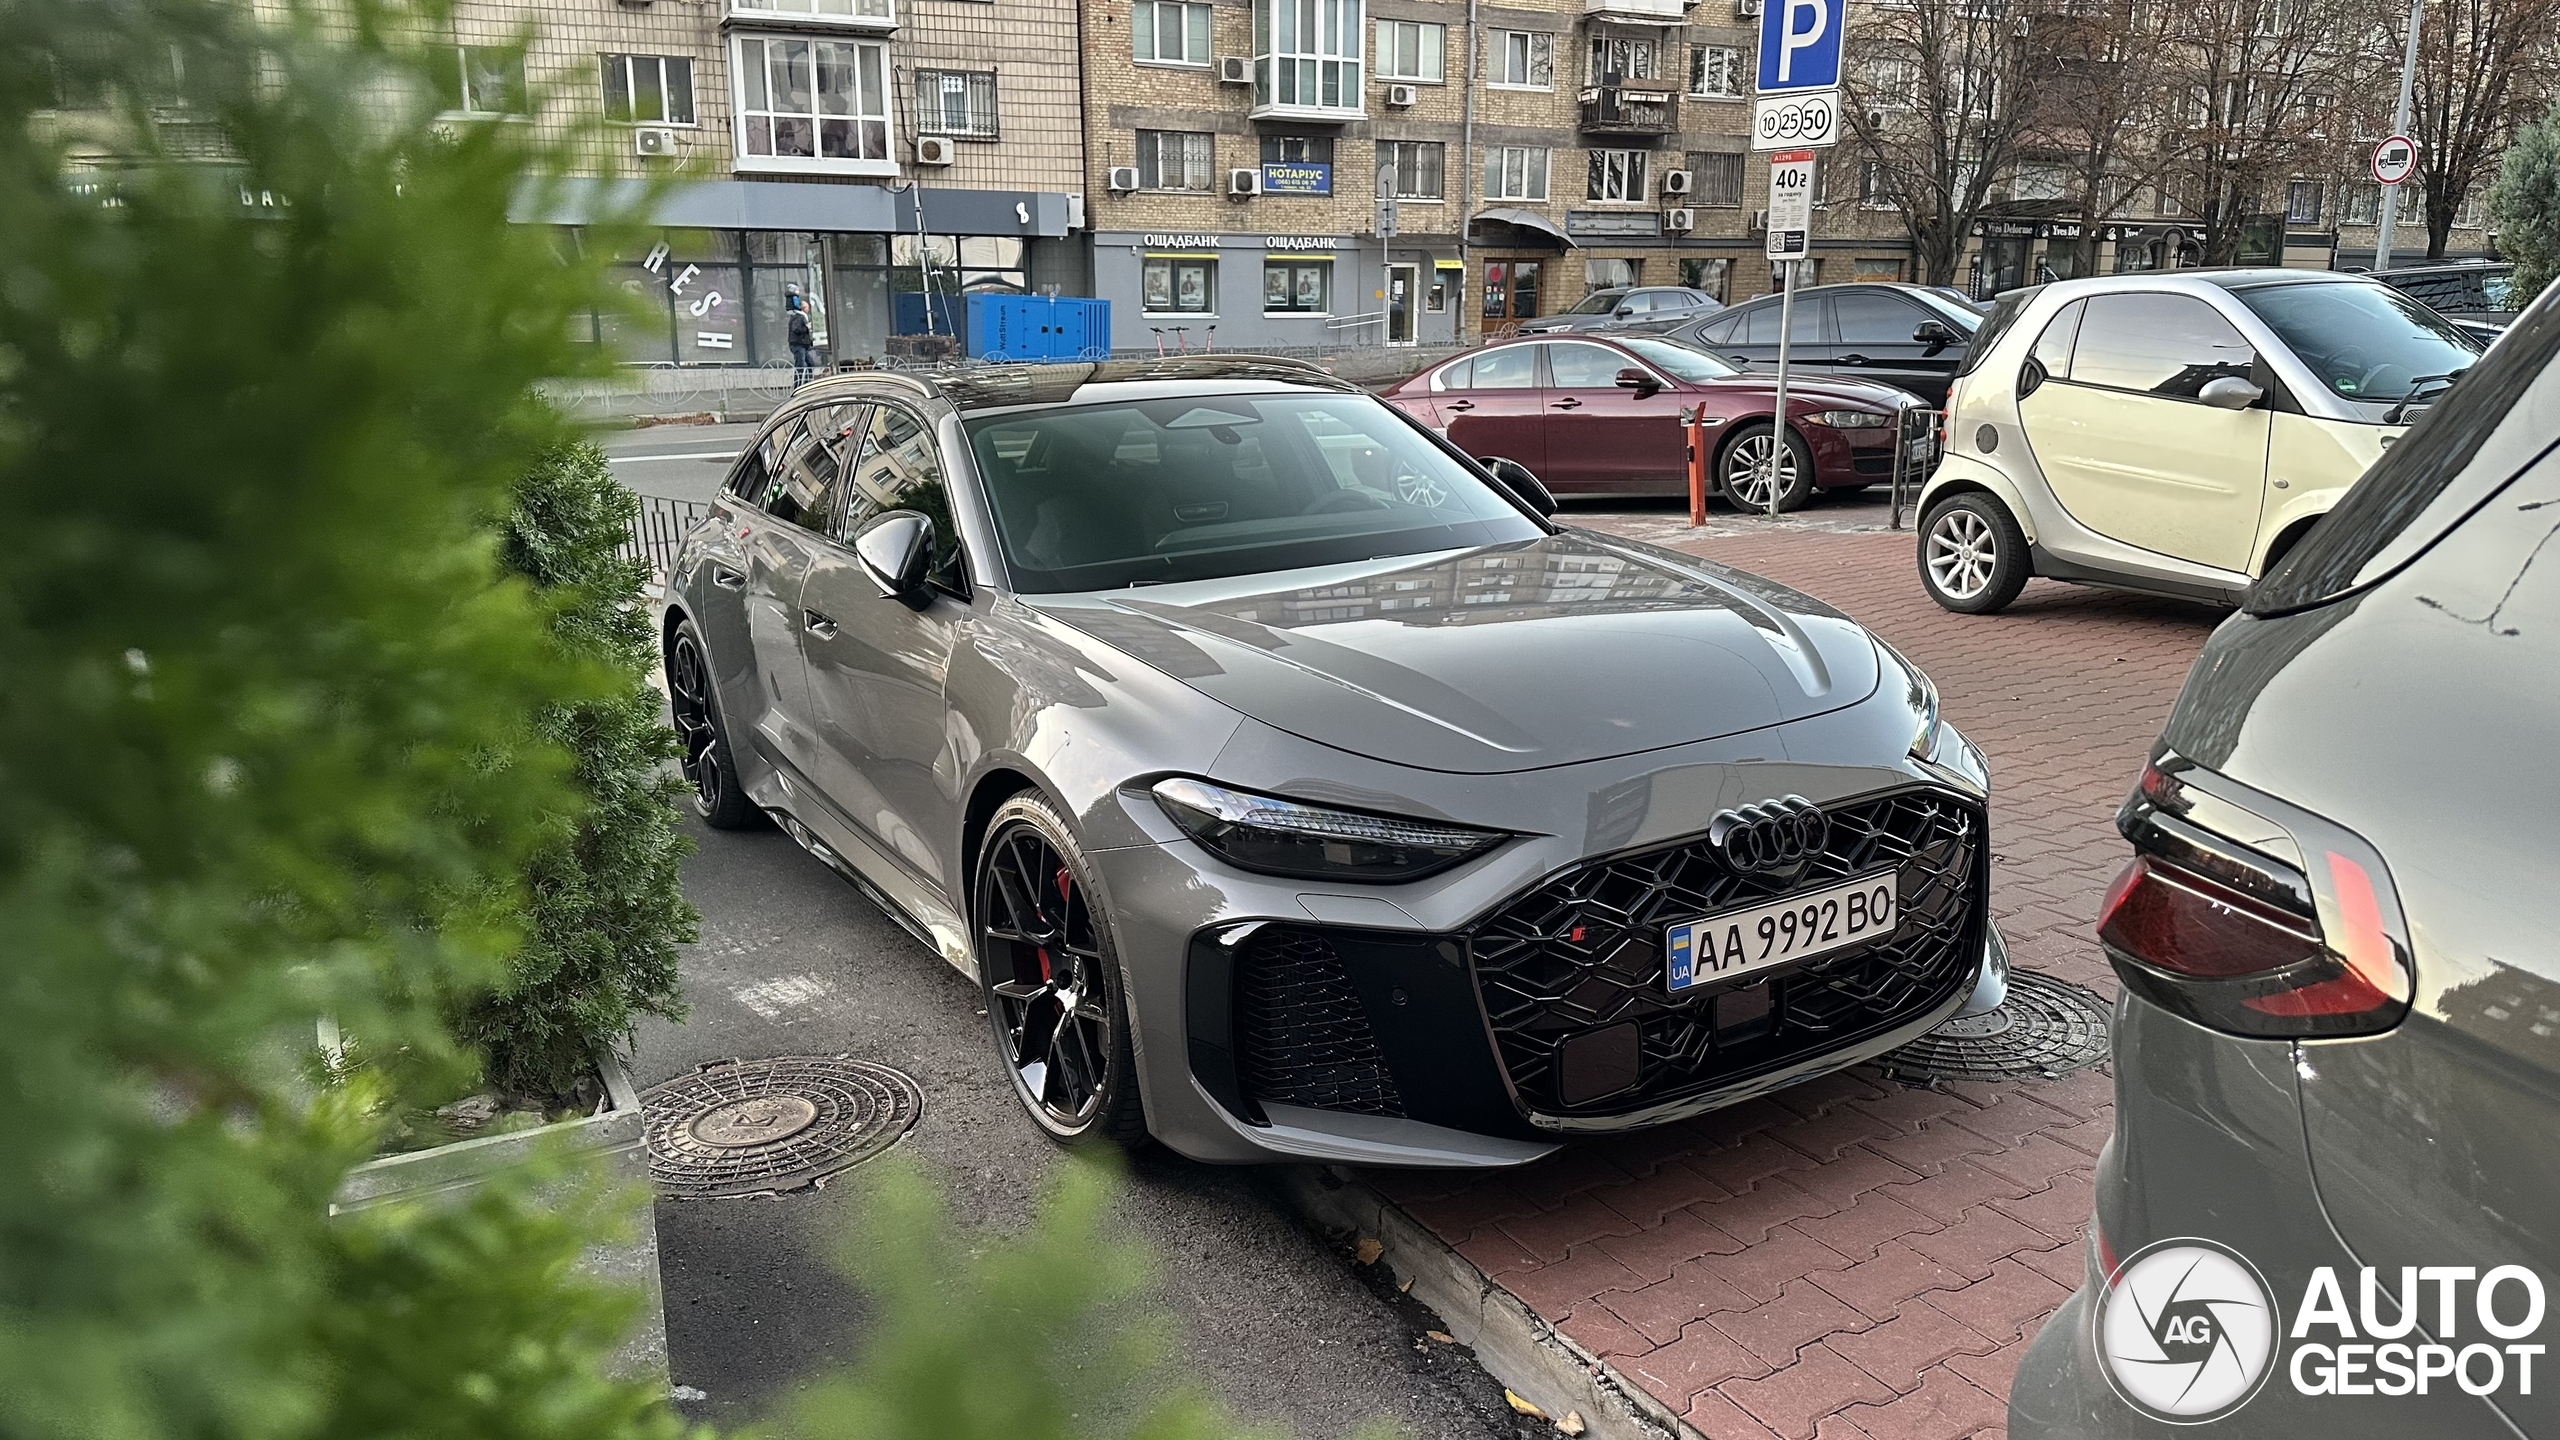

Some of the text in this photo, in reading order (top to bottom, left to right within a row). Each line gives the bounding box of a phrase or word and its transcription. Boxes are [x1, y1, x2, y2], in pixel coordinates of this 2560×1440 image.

[1778, 0, 1828, 82] P
[1763, 109, 1826, 132] 10 25 50
[1268, 168, 1323, 180] НОТАРІУС
[2052, 225, 2068, 237] Yves
[1143, 234, 1220, 249] ОЩАДБАНК
[1265, 236, 1337, 250] ОЩАДБАНК
[1694, 884, 1891, 977] AA 9992 BO
[1672, 964, 1690, 981] UA
